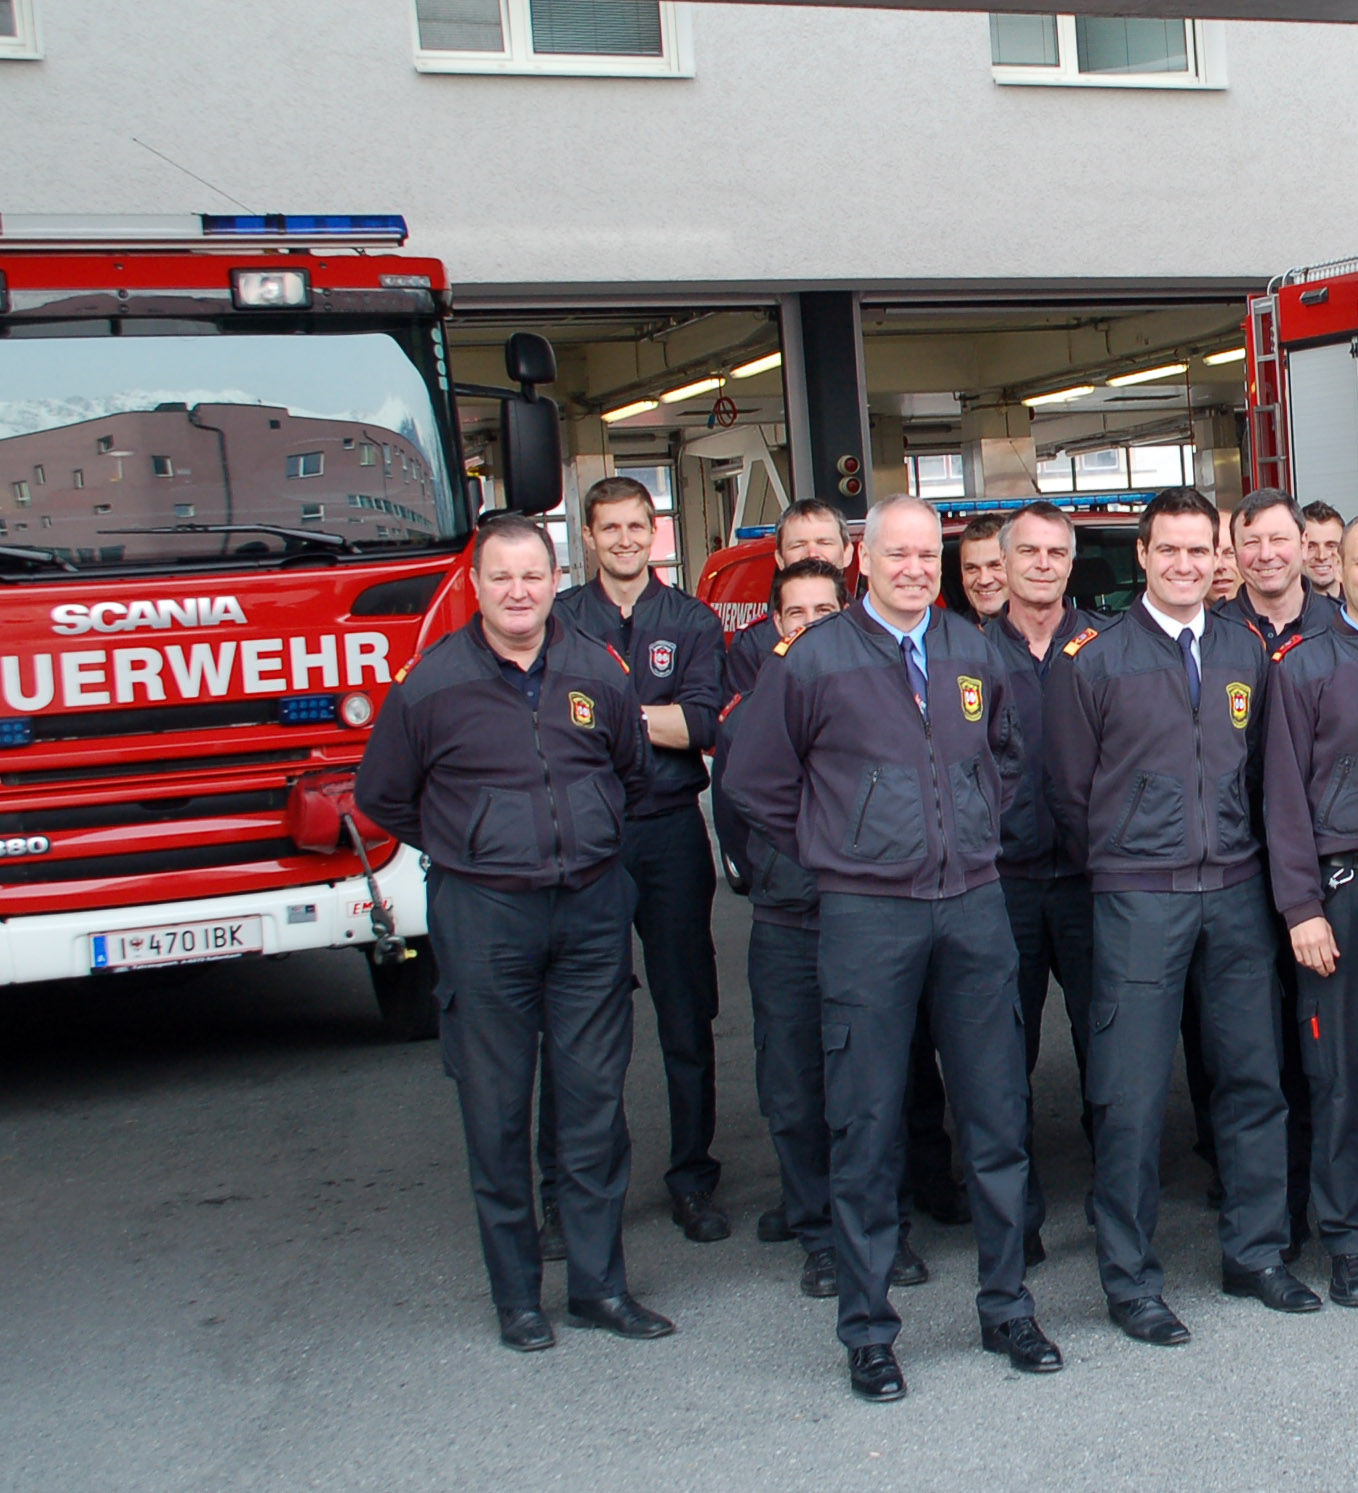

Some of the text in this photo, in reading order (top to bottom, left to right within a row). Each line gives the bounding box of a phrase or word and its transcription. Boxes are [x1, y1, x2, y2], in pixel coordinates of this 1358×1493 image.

[51, 595, 248, 635] SCANIA
[1, 631, 393, 711] UERWEHR
[149, 930, 196, 955] 470
[205, 924, 244, 949] IBK
